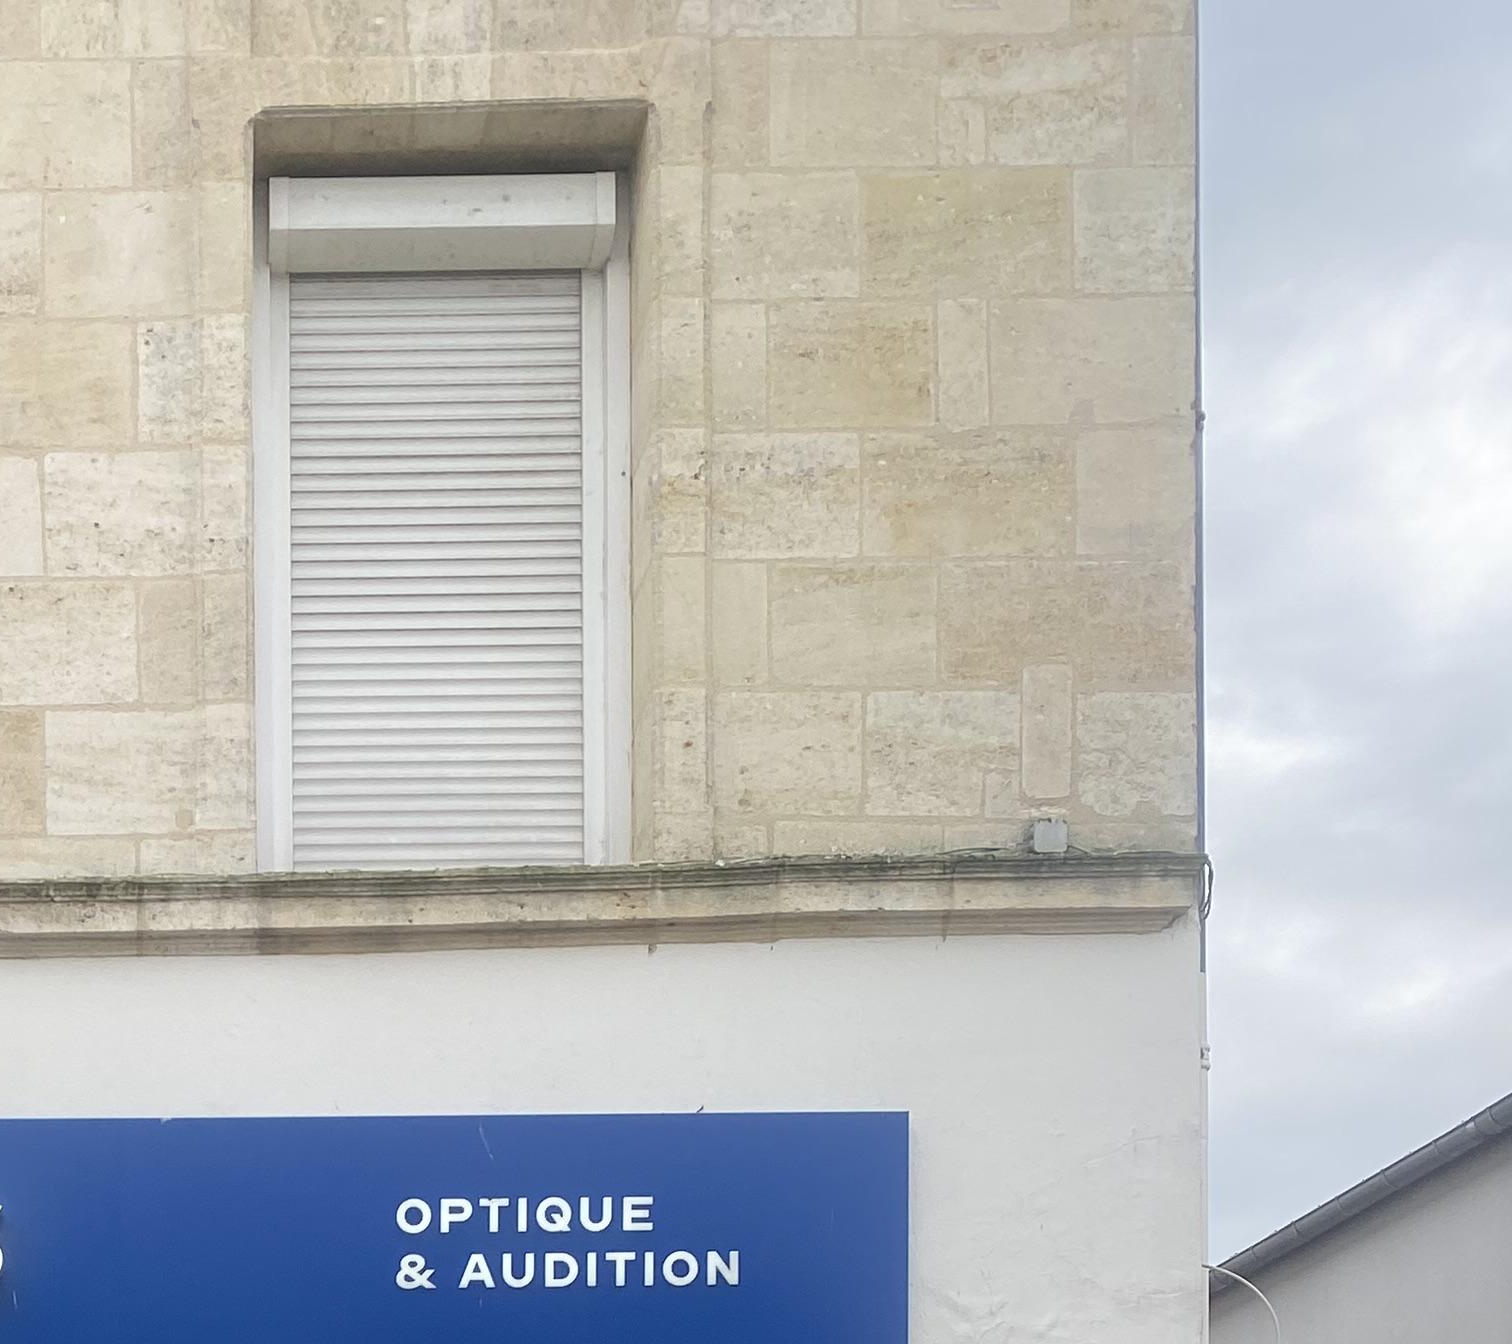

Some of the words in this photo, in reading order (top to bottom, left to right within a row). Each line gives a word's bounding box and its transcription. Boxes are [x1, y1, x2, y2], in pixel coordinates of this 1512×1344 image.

[395, 1195, 655, 1235] OPTIQUE
[395, 1254, 436, 1290] &
[458, 1250, 741, 1289] AUDITION
